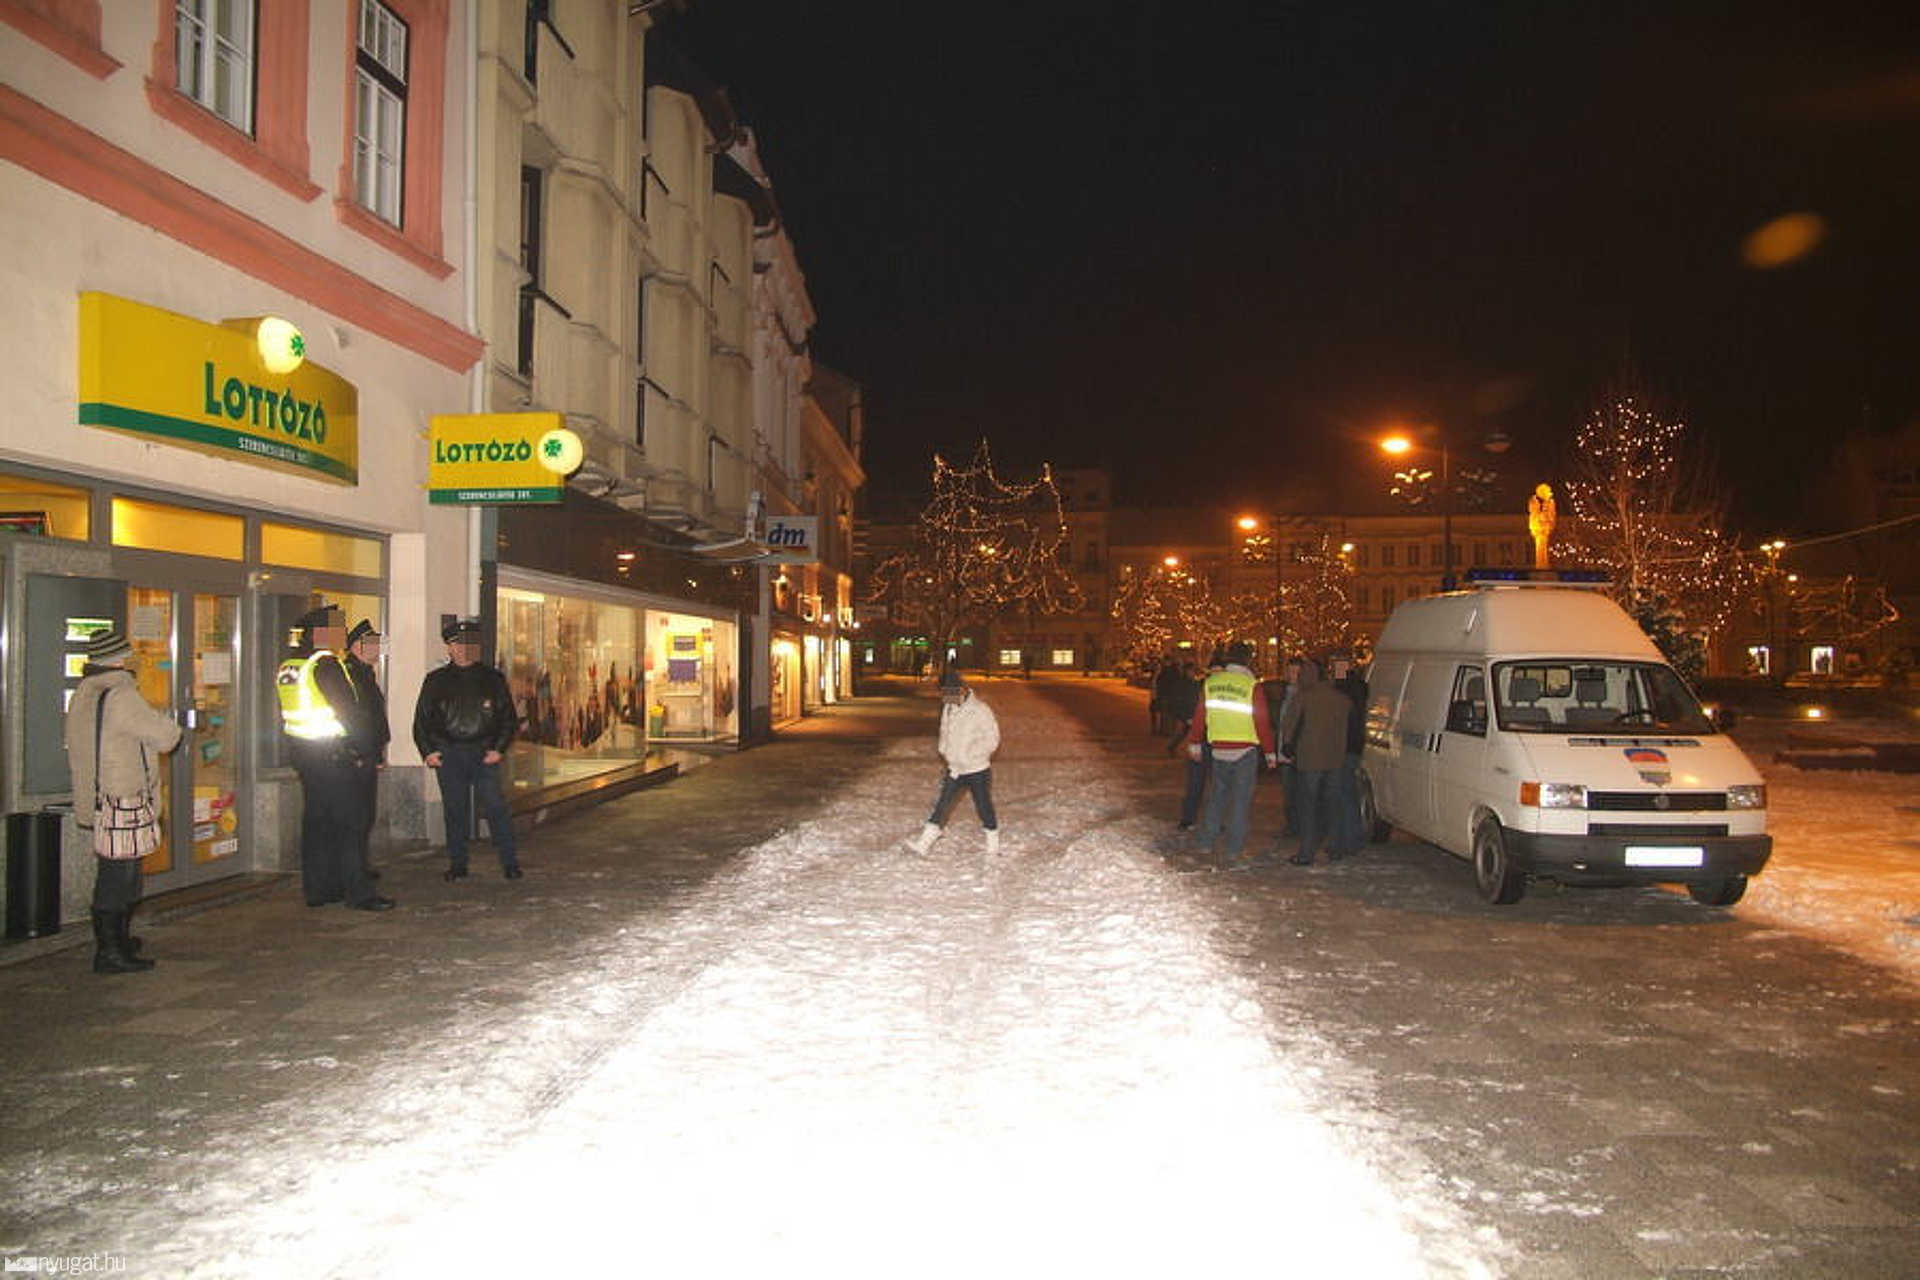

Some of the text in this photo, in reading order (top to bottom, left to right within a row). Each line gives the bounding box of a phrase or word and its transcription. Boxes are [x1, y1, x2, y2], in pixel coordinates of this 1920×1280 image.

[205, 361, 325, 443] LOTTÓZÓ
[436, 437, 532, 462] LOTTÓZÓ
[768, 522, 805, 545] dm
